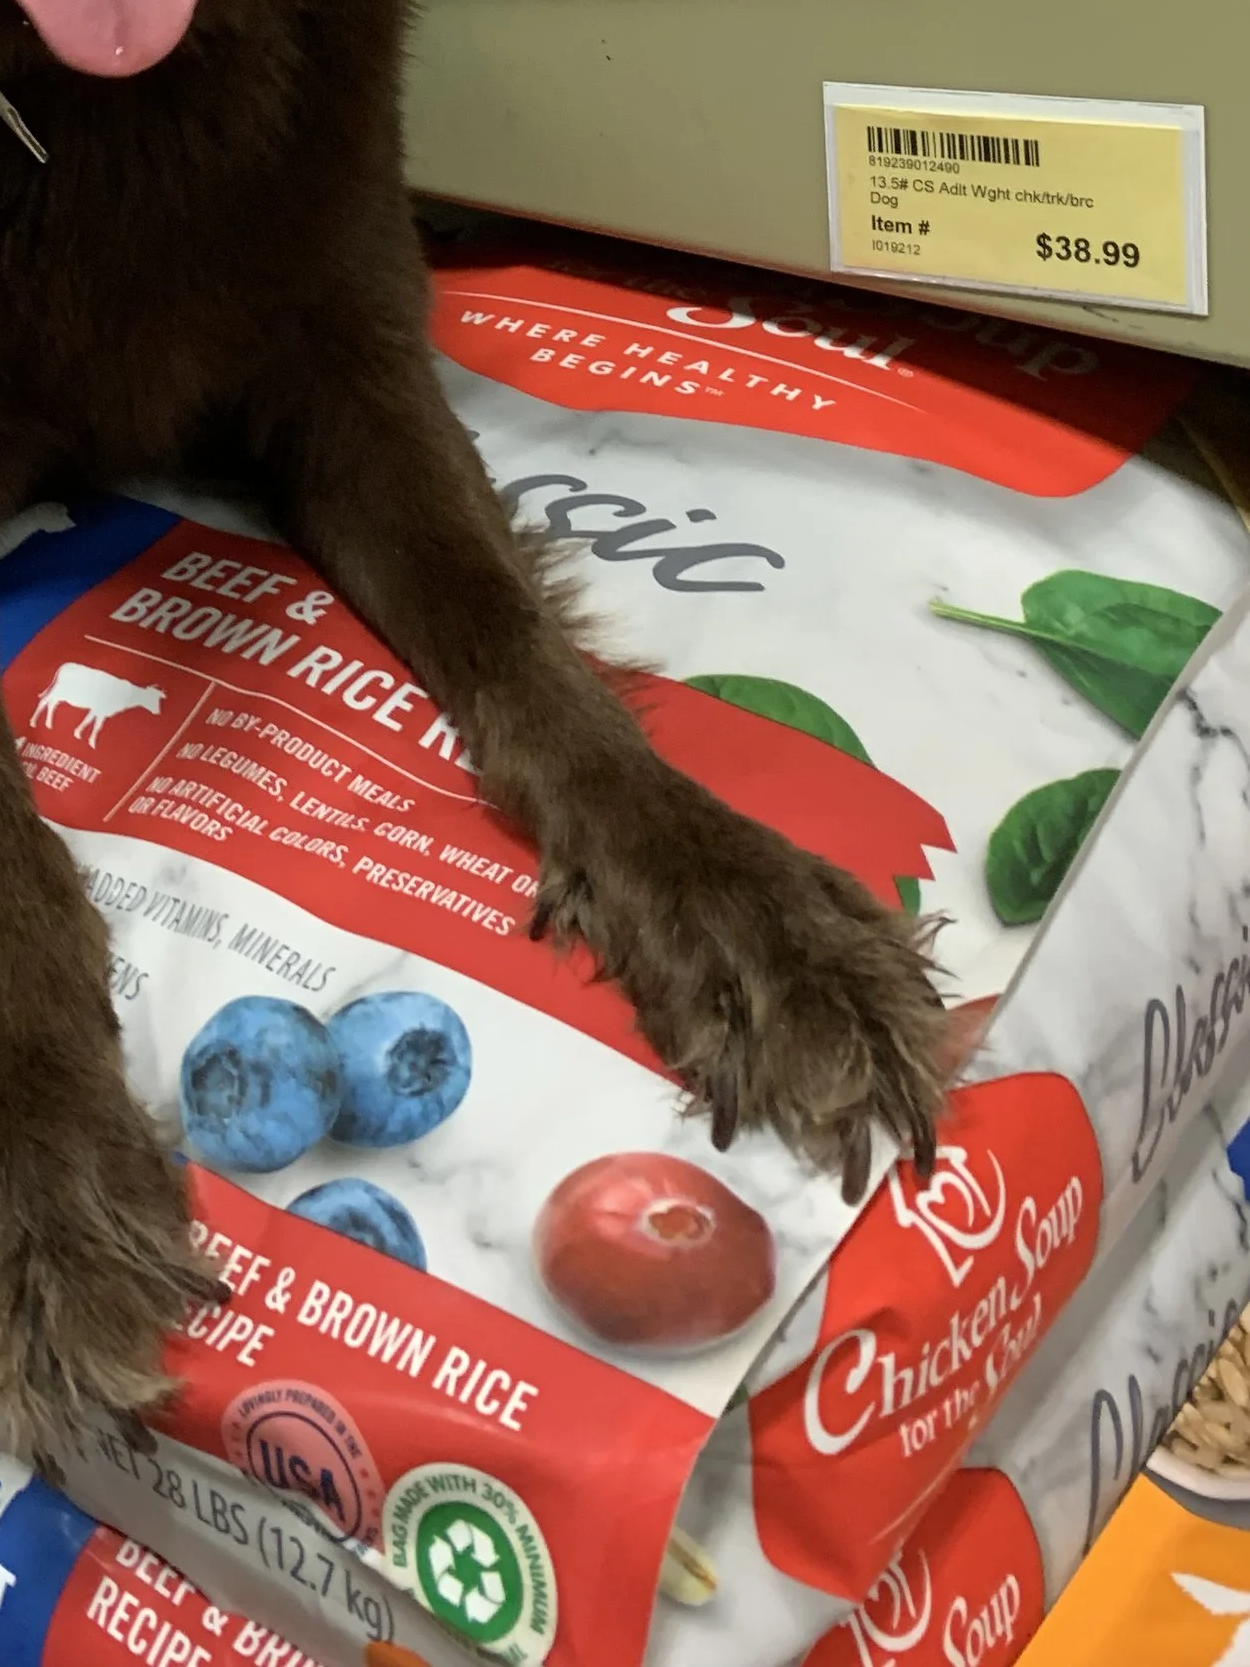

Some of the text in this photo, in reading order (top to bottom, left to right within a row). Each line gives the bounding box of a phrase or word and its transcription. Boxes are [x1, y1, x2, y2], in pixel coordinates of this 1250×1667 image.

[869, 175, 1095, 209] 13.5# CS Adlt Wght chk/trk/brc
[870, 191, 899, 209] Dog
[871, 215, 931, 236] Item #
[1035, 232, 1141, 269] $38.99
[460, 309, 608, 353] WHERE
[623, 338, 838, 414] HEALTHY
[160, 550, 336, 626] BEEF &
[108, 586, 430, 733] BROWN RICE
[22, 742, 102, 784] INGREDIENT
[36, 769, 74, 793] BEEF
[205, 708, 416, 813] NO BY-PRODUCT MEALS
[152, 800, 234, 842] FLAVORS
[168, 778, 517, 937] ARTIFICIAL COLORS, PRESERVATIVES
[200, 744, 514, 884] LEGUMES, CORN, WHEAT
[227, 920, 337, 994] MINERALS
[1008, 1174, 1085, 1311] Soup
[264, 1267, 540, 1432] & BROWN RICE
[803, 1275, 1009, 1456] Chicken
[148, 1457, 335, 1598] 28 LBS (12.7
[392, 1473, 549, 1636] BAG MADE WITH 30% MINIMUM
